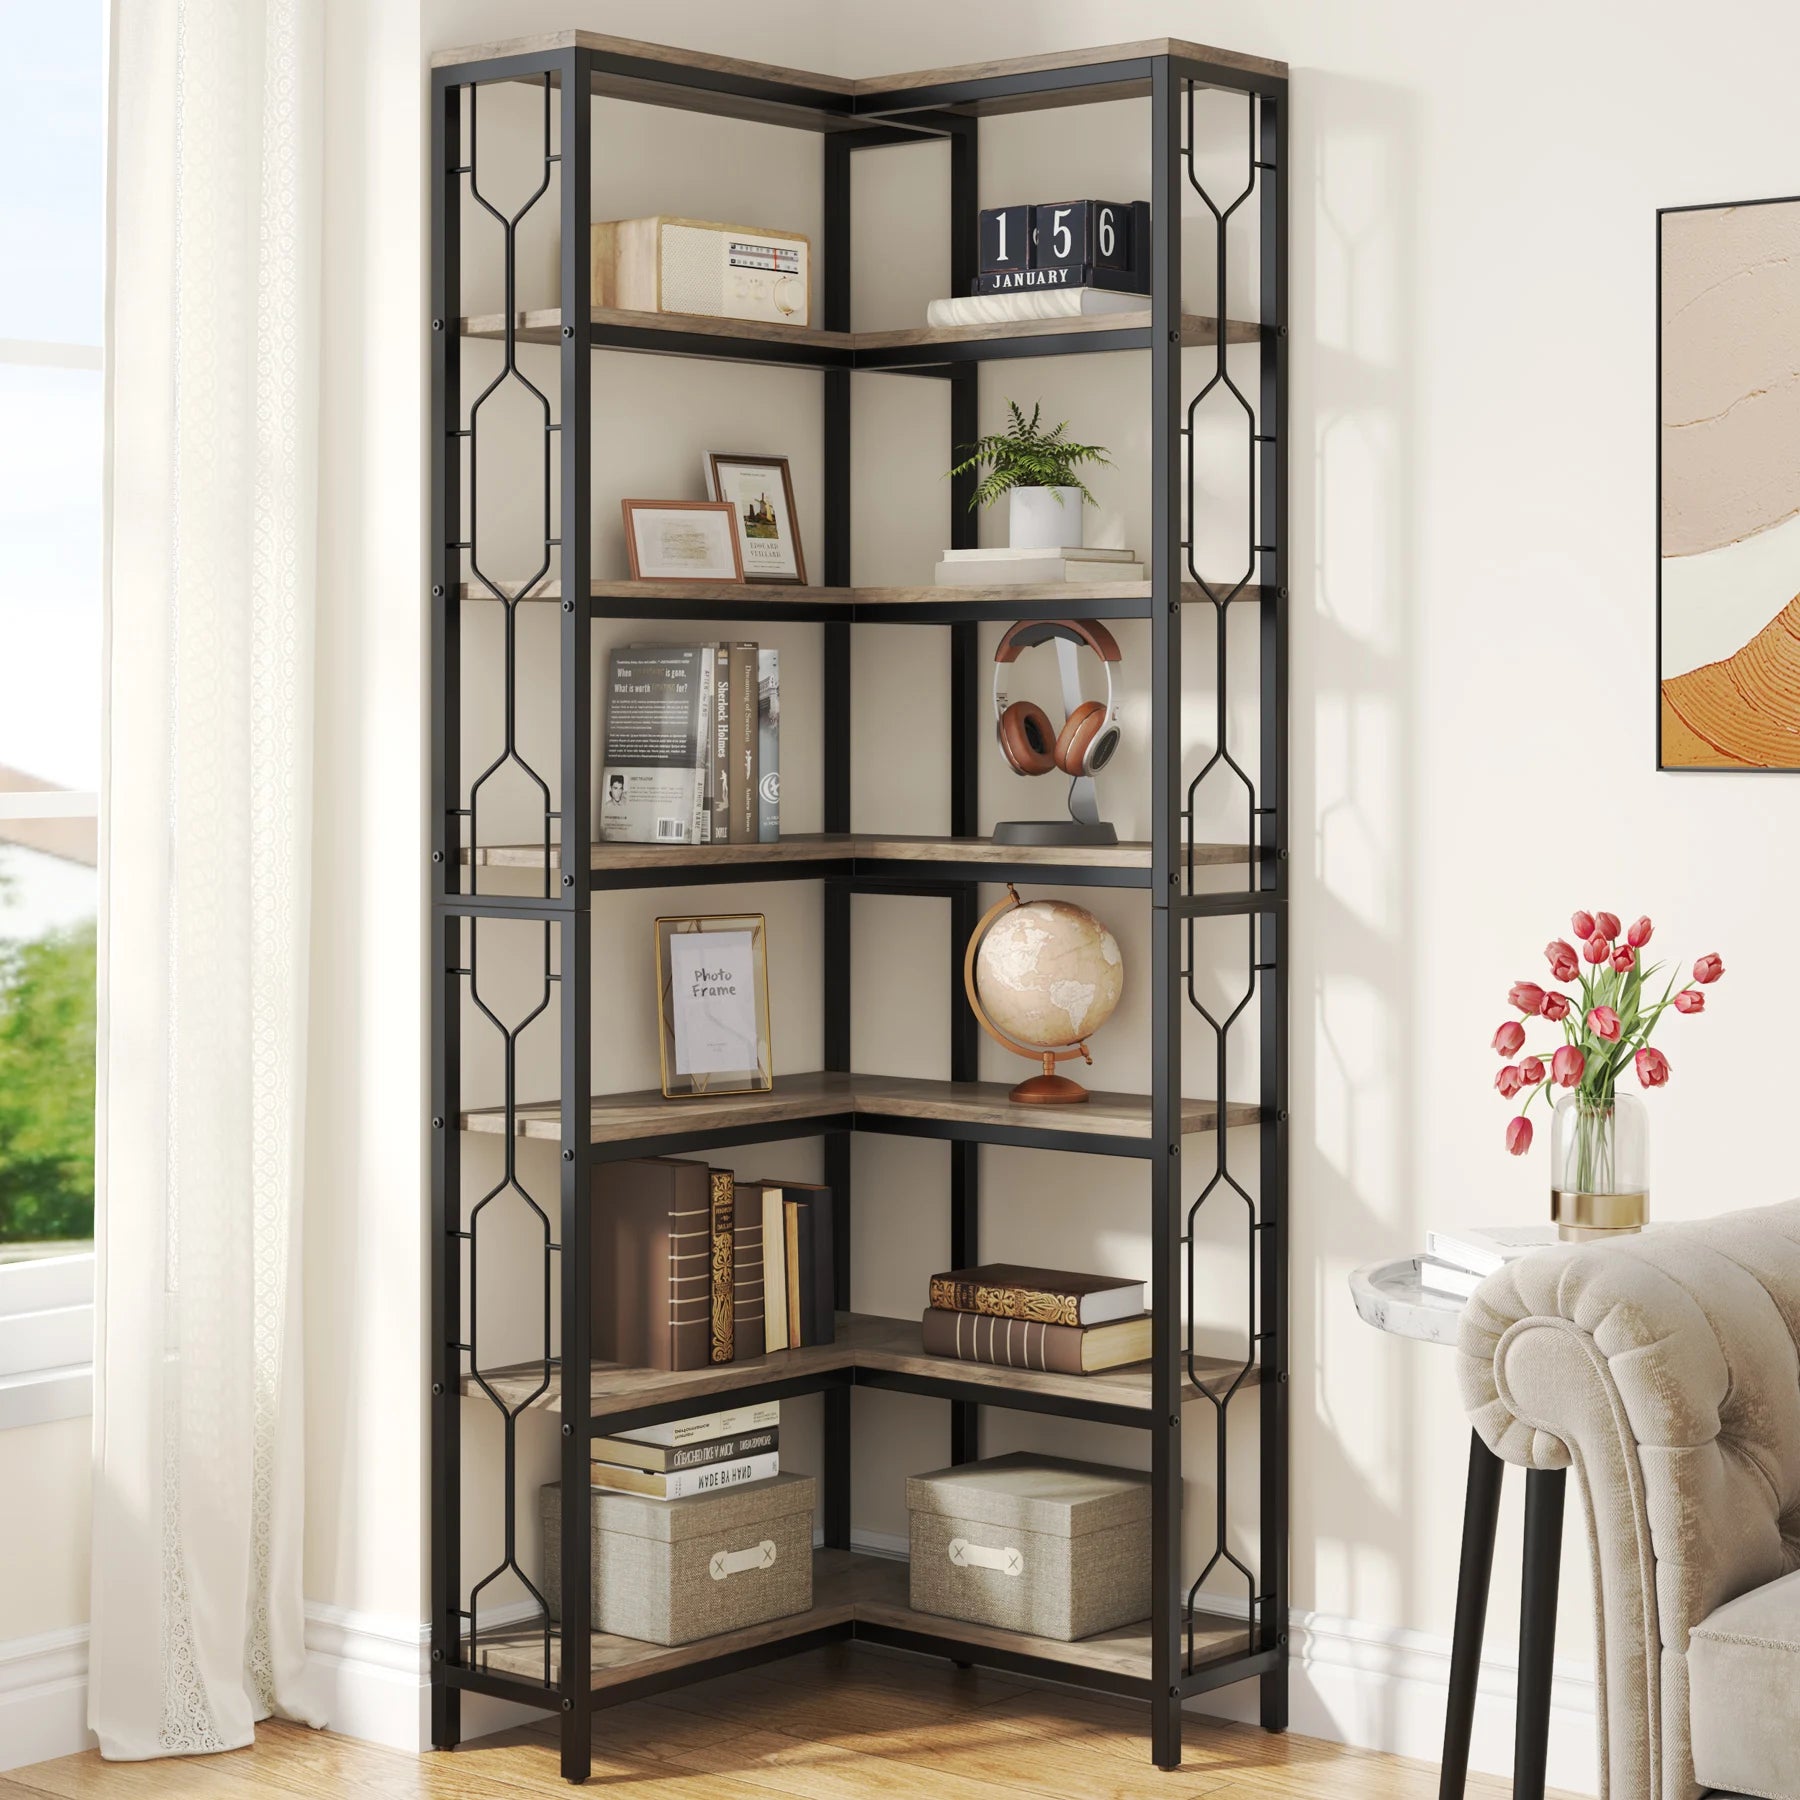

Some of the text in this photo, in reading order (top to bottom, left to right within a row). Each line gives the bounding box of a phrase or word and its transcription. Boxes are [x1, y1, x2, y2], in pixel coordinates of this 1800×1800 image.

[995, 208, 1115, 261] 1 5 6
[992, 268, 1069, 289] JANUARY
[617, 667, 632, 678] When
[614, 683, 628, 694] What
[628, 683, 634, 693] is
[634, 683, 651, 694] worth
[744, 665, 752, 703] Dreaming
[745, 703, 752, 712] of
[717, 681, 729, 759] Sherlock Holmes
[694, 968, 732, 982] Photo
[692, 985, 737, 997] Frame
